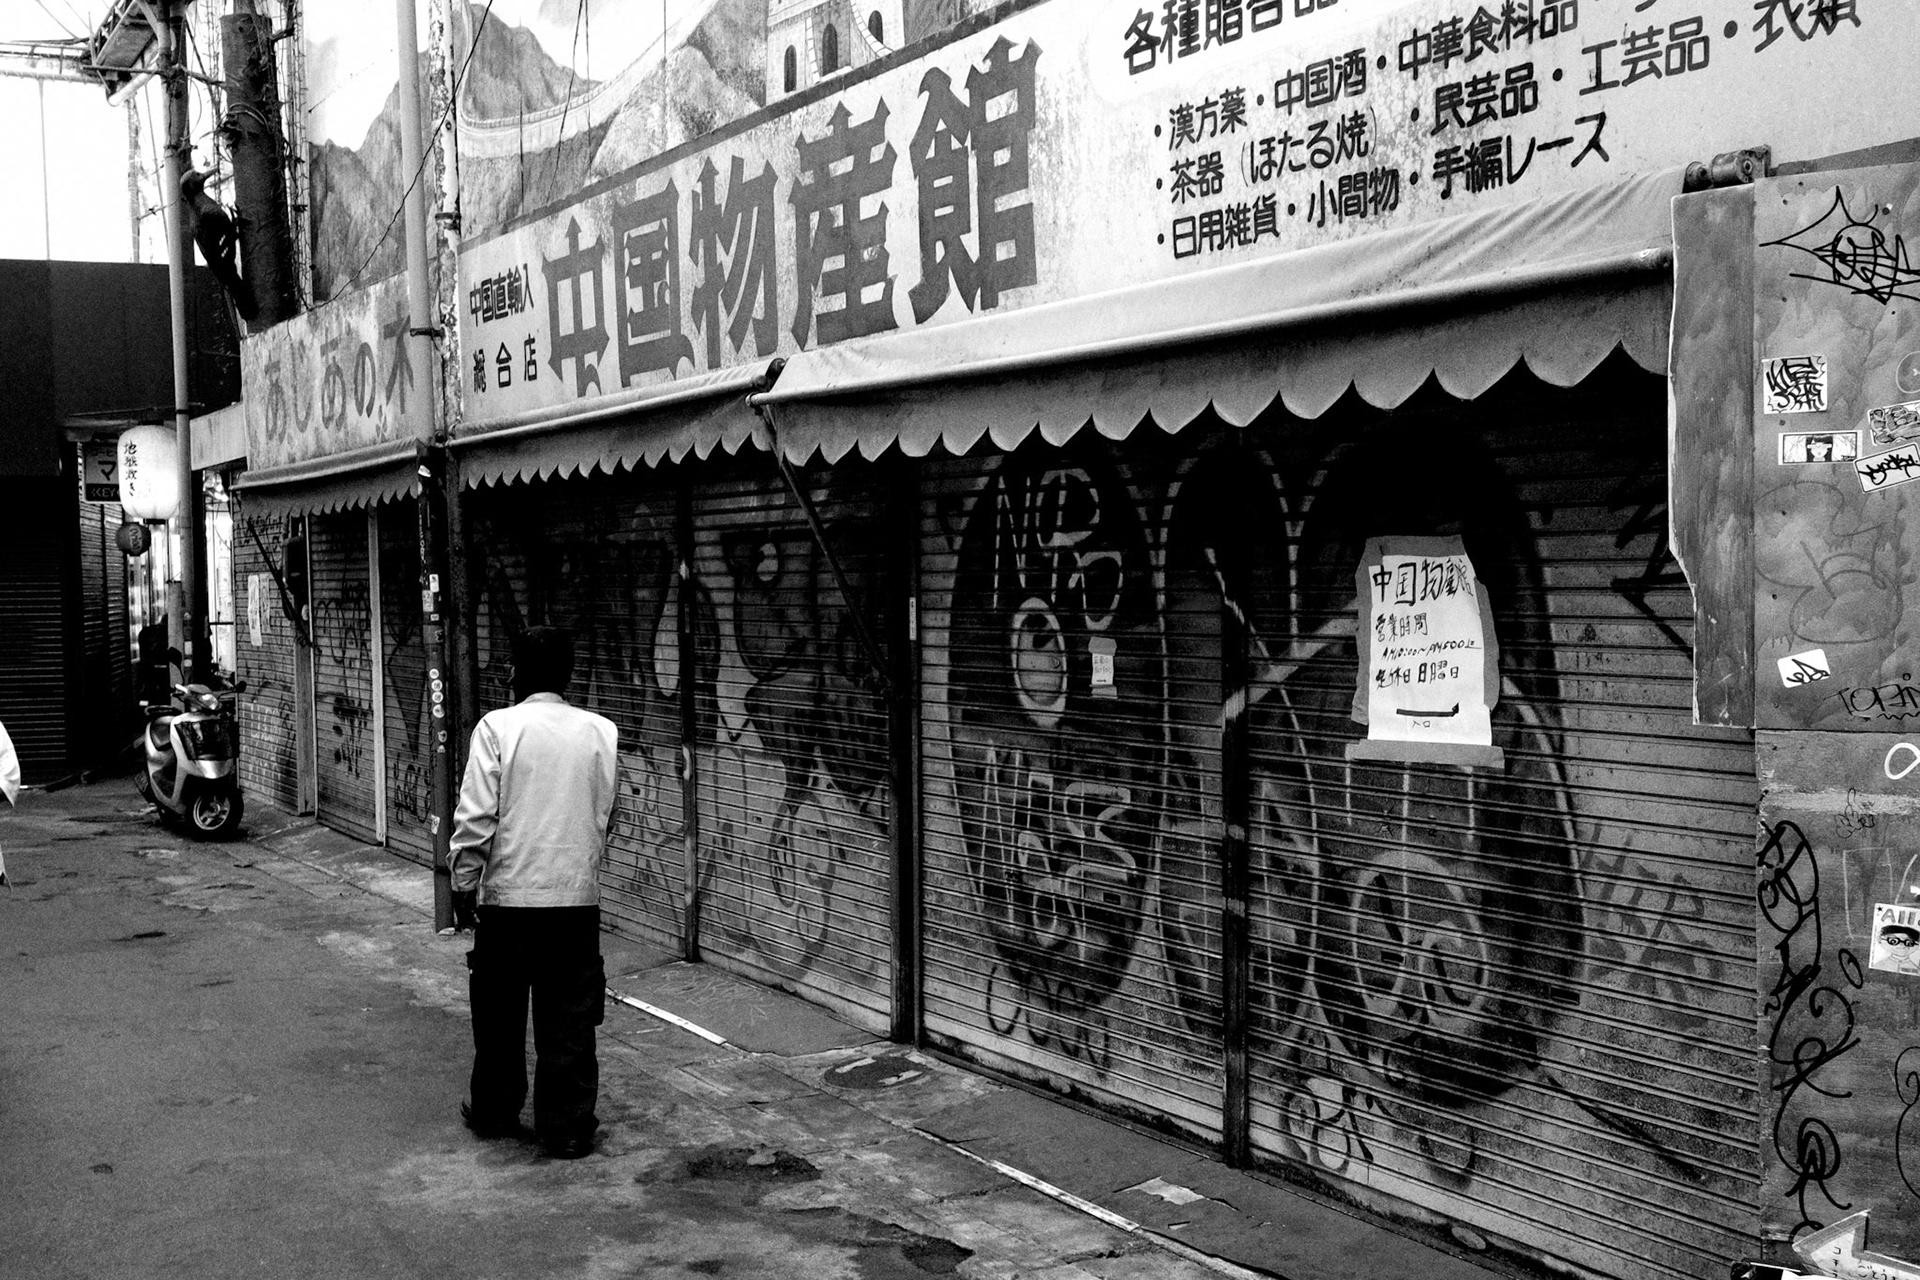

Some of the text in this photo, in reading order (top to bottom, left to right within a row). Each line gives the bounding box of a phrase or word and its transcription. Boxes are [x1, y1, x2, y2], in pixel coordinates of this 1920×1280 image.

[470, 263, 534, 327] 中国直輸入
[541, 33, 1044, 399] 中国物産館
